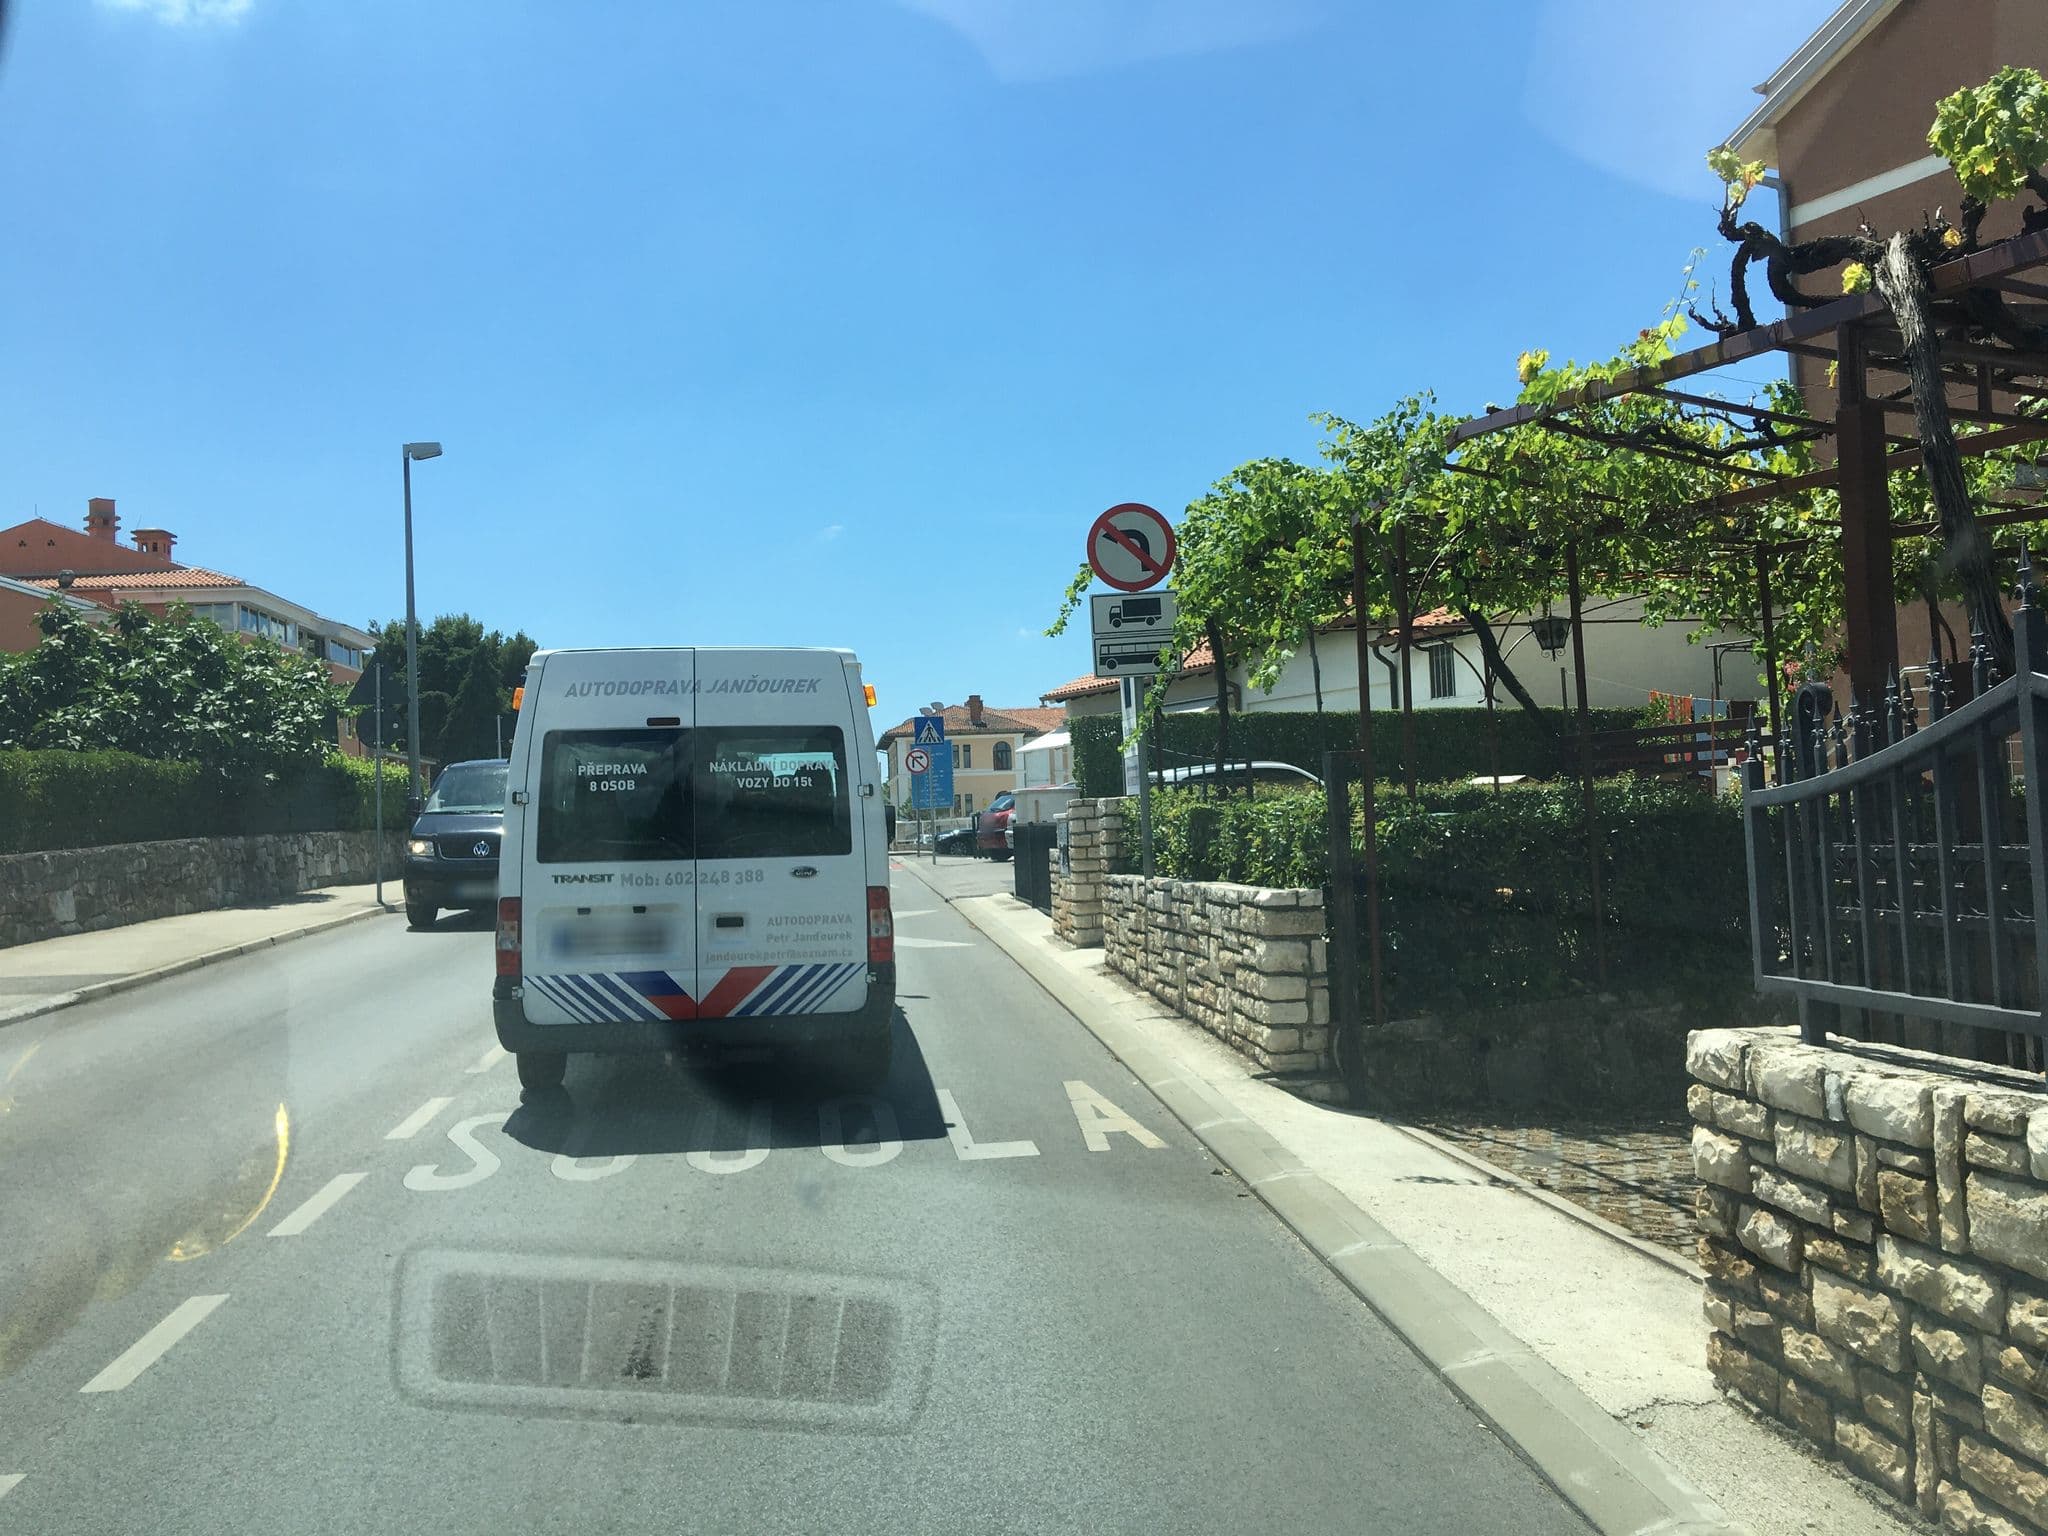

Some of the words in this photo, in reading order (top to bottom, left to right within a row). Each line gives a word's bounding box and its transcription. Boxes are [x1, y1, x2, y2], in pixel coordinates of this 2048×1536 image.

[564, 679, 701, 697] AUTODOPRAVA
[578, 761, 647, 775] PŘEPRAVA
[709, 757, 777, 772] NÁKLADNÍ
[780, 758, 839, 771] DOPRAVA
[589, 781, 597, 791] 8
[600, 780, 635, 791] OSOB
[737, 777, 769, 788] VOZY
[773, 777, 790, 787] DO
[794, 776, 812, 787] 15t
[552, 873, 615, 884] TRANSIT
[621, 873, 660, 887] Mob:
[664, 871, 694, 886] 602
[700, 870, 730, 885] 248
[735, 869, 764, 885] 388
[766, 914, 853, 927] AUTODOPRAVA
[766, 933, 788, 943] Petr
